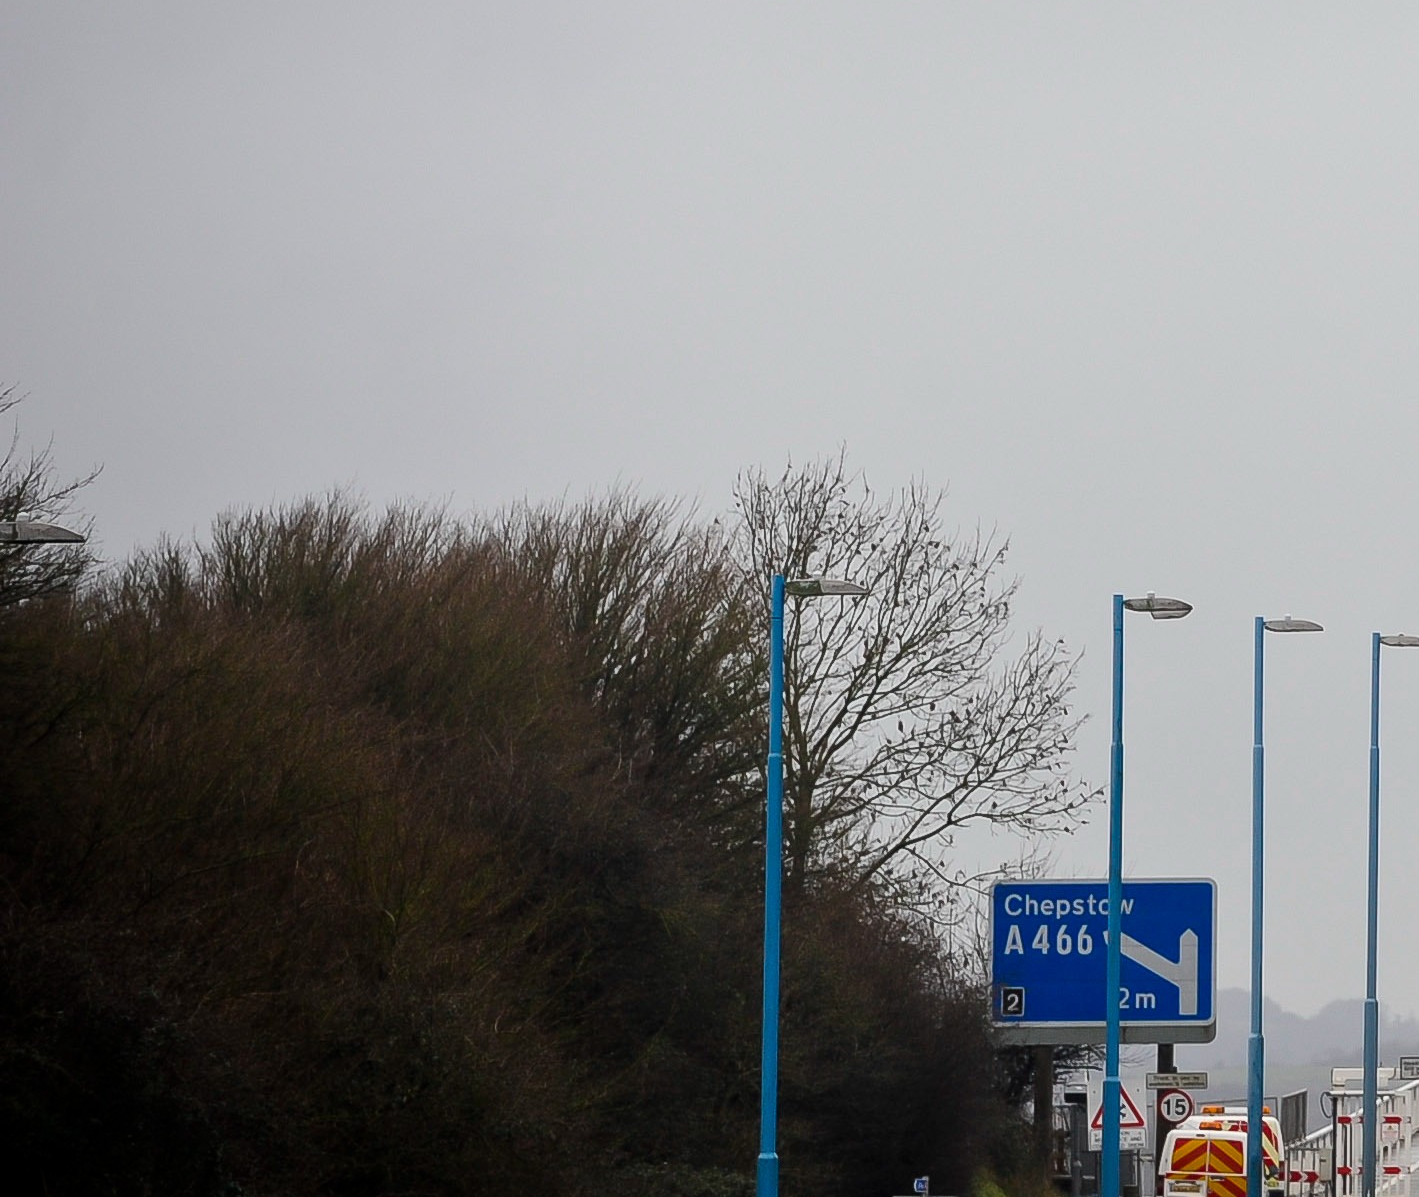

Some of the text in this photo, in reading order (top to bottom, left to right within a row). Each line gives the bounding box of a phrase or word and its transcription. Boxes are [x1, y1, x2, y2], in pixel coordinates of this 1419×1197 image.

[1004, 893, 1135, 920] Chepstow
[1007, 993, 1020, 1011] 2
[1163, 1098, 1187, 1116] 15
